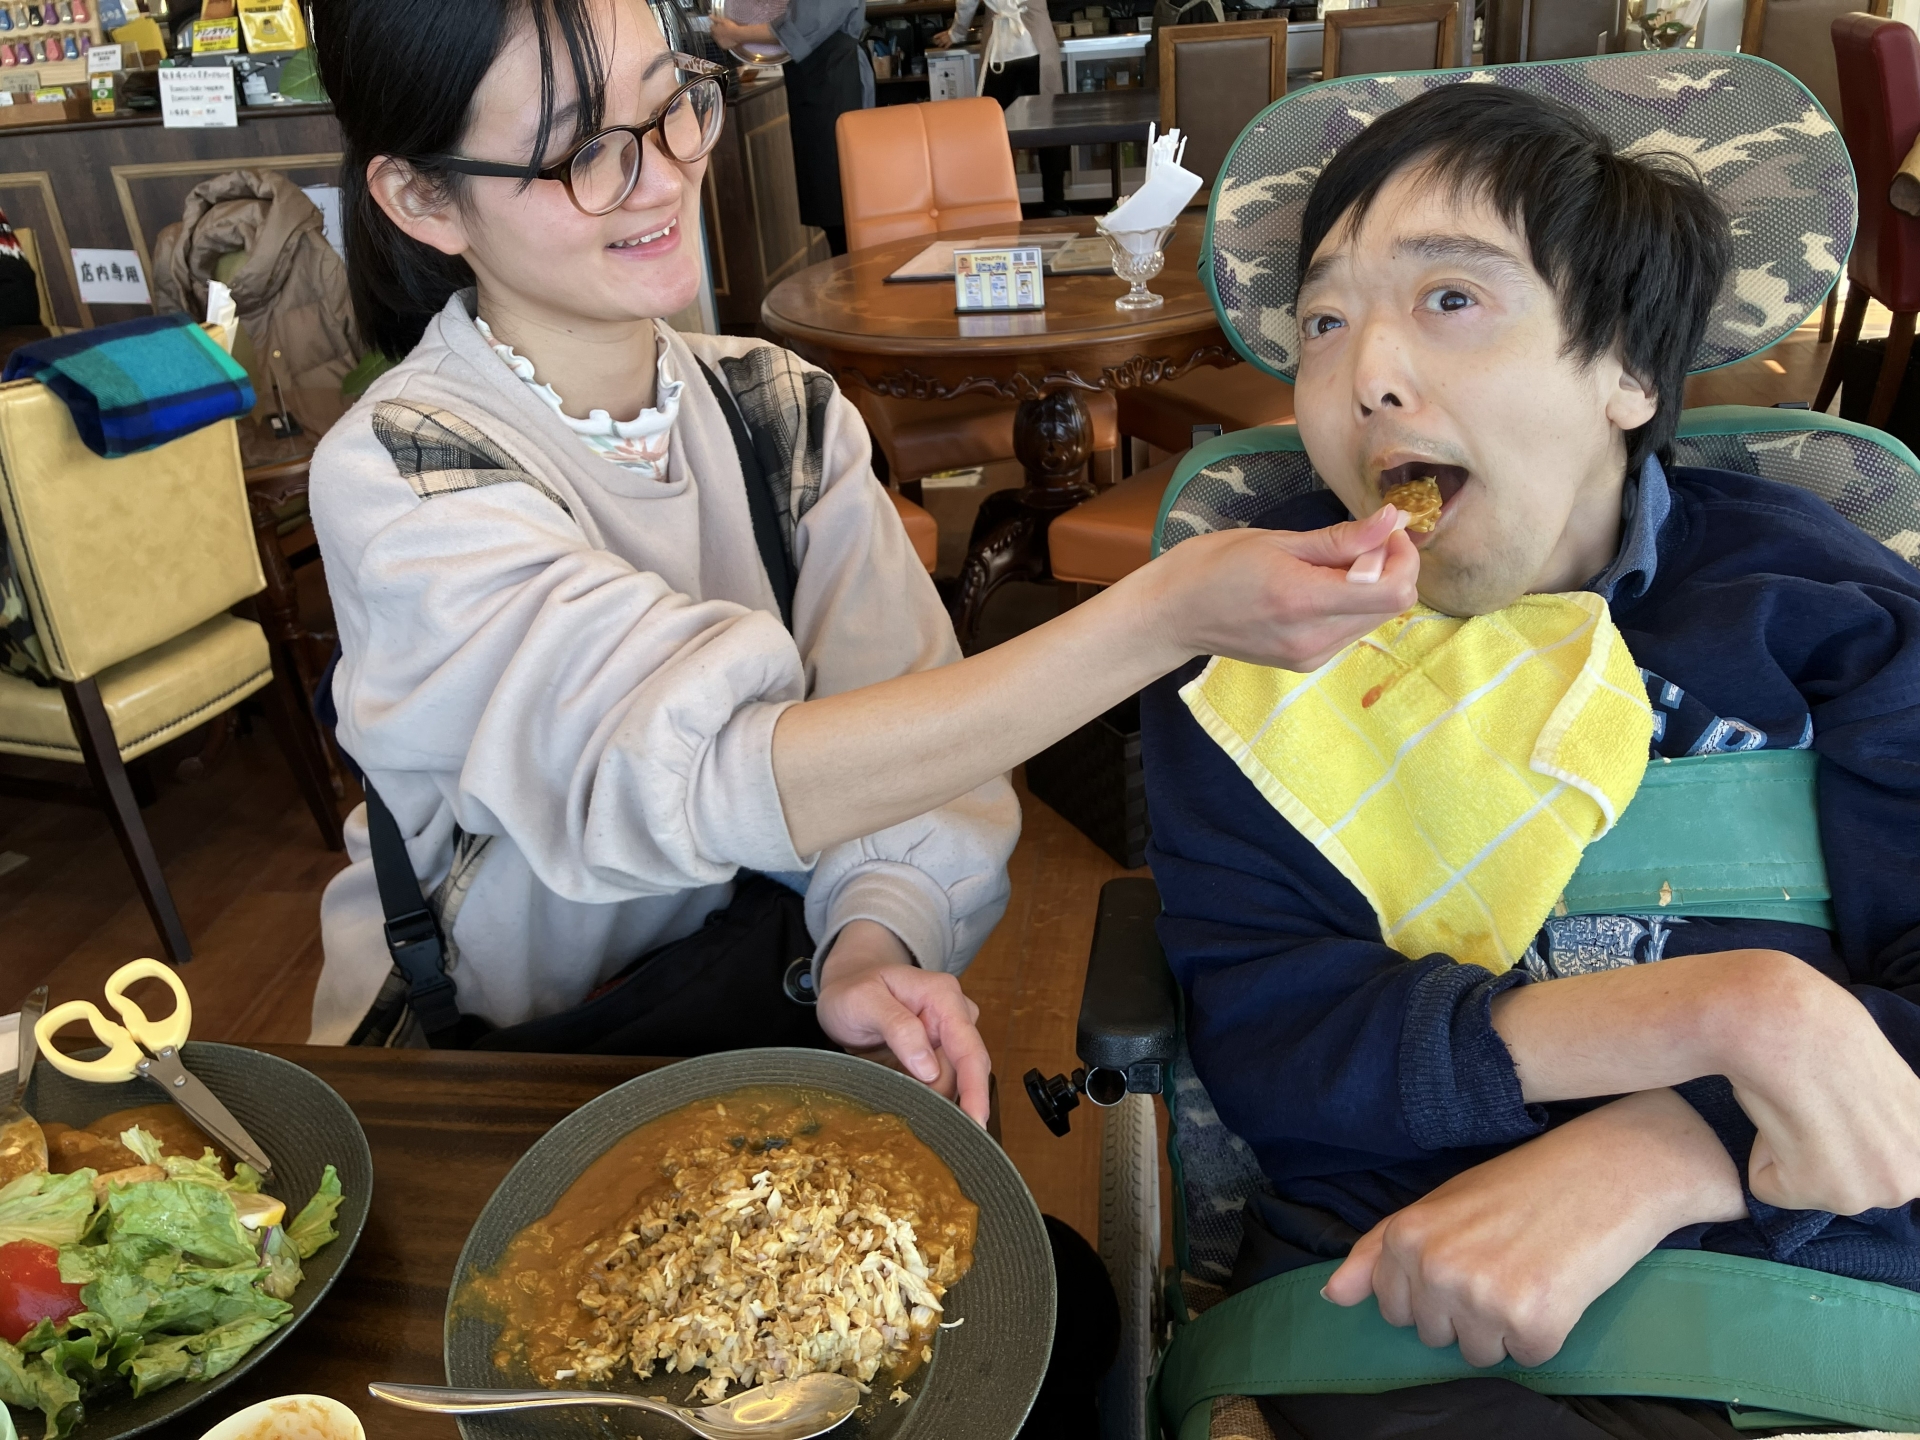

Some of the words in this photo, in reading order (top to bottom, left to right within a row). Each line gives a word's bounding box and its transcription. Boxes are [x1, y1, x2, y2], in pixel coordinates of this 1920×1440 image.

[81, 261, 140, 283] 店内専用
[976, 262, 1008, 272] リニューアル
